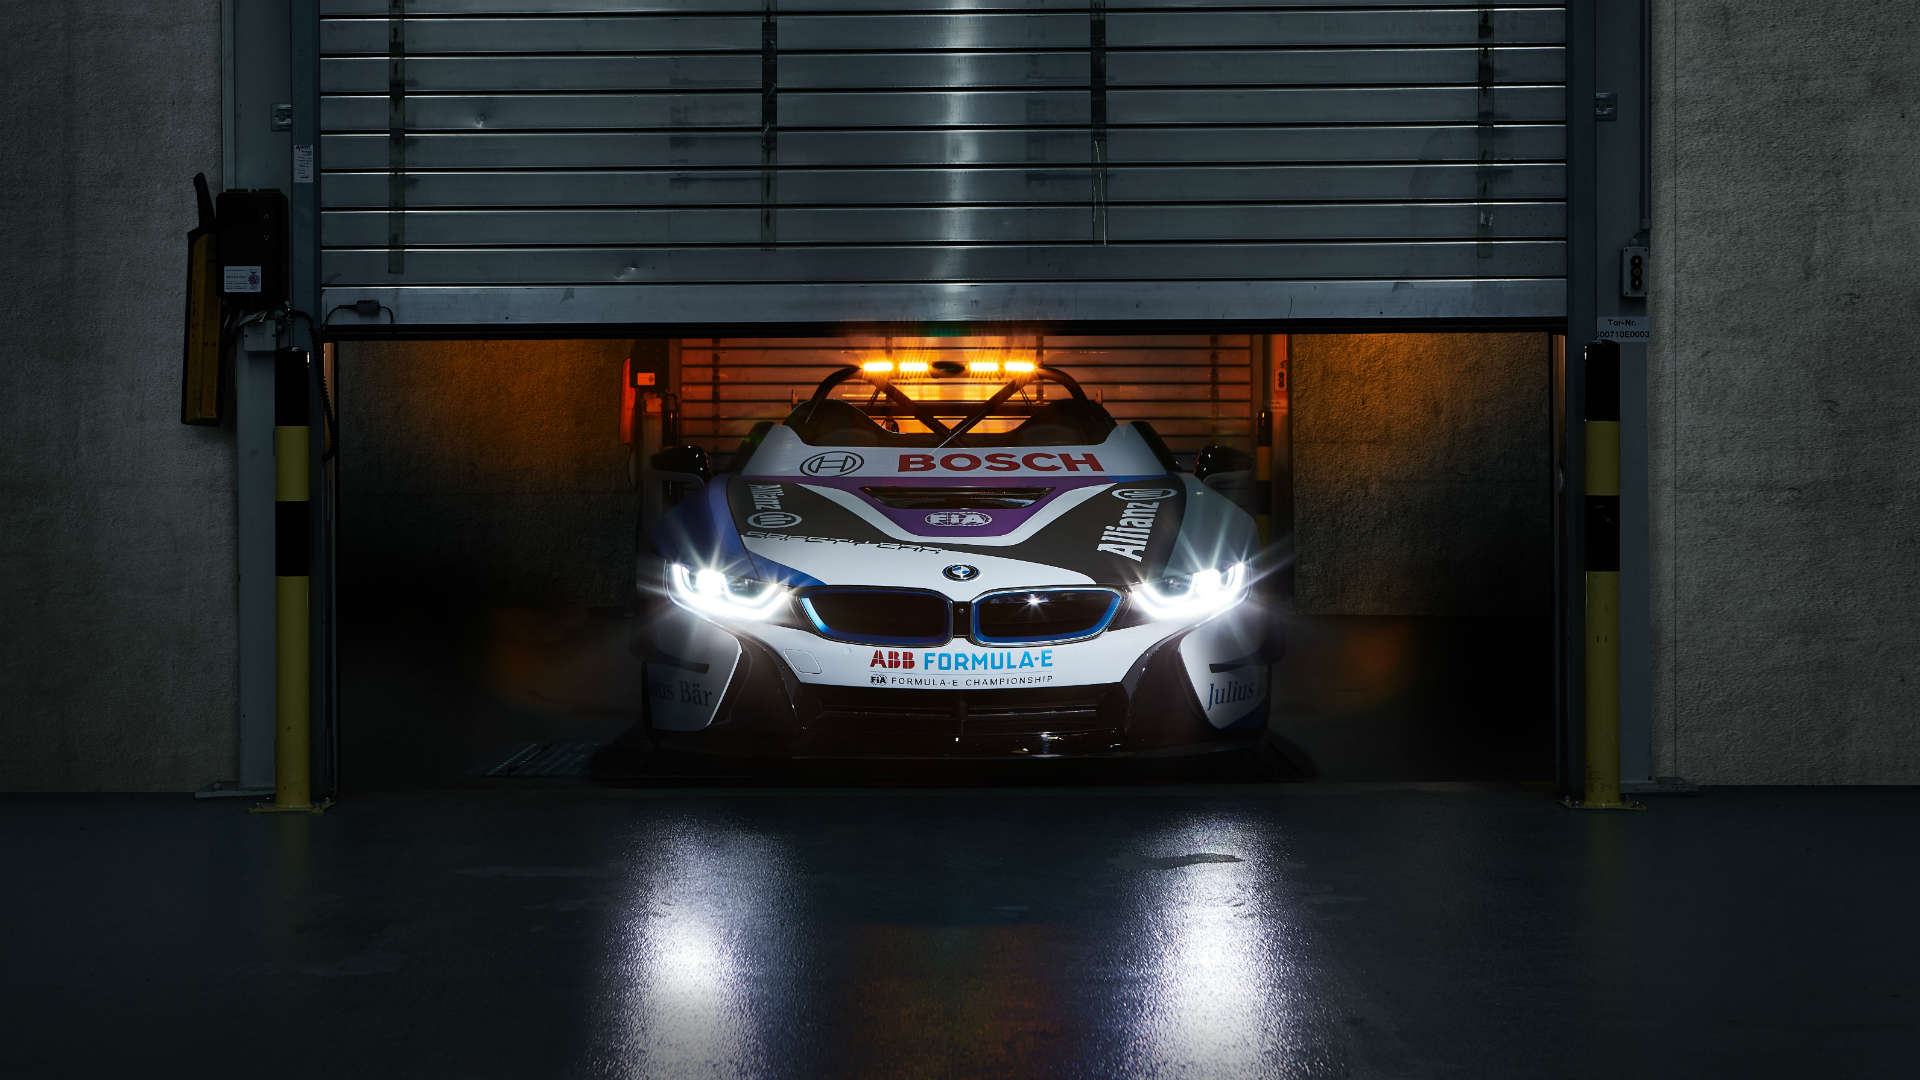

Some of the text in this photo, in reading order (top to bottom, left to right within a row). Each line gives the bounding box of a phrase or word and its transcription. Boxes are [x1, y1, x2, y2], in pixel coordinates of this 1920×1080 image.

[897, 452, 1105, 473] BOSCH
[929, 513, 985, 525] FIA
[1096, 502, 1160, 562] Allianz
[870, 649, 915, 670] ABB
[870, 674, 887, 686] FIA
[965, 675, 1053, 687] CHAMPIONSHIP
[1207, 680, 1254, 711] Julius
